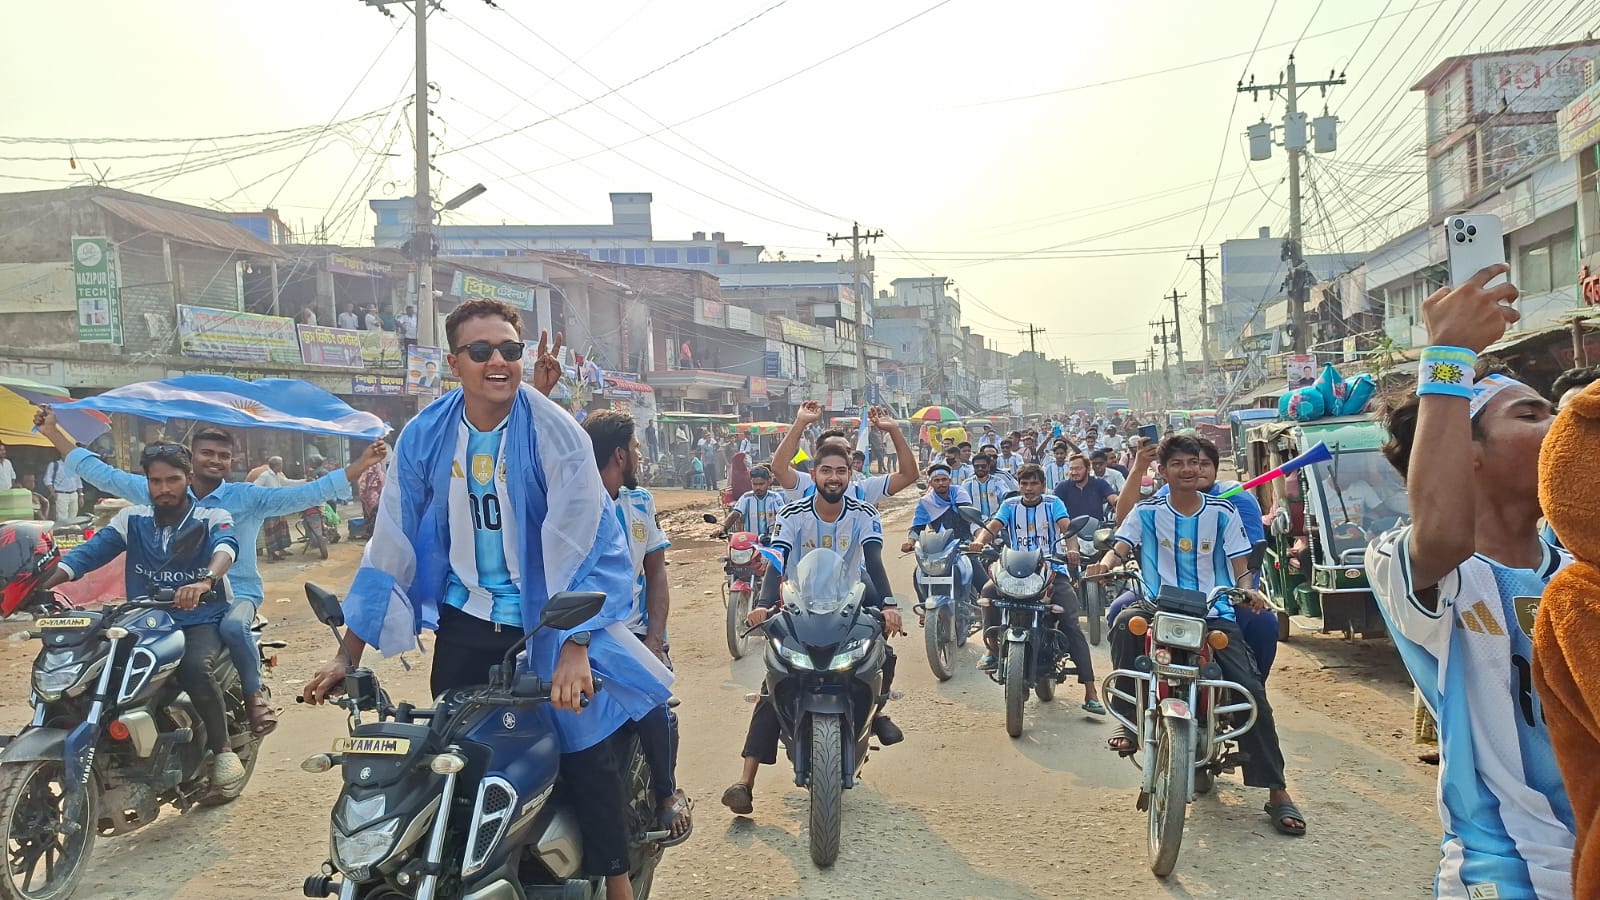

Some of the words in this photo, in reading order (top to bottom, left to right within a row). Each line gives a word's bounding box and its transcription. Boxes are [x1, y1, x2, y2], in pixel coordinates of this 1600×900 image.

[76, 272, 107, 285] NAZIPUR
[78, 287, 107, 297] TECH
[469, 493, 502, 531] 10
[1016, 535, 1051, 547] RGENTIN
[350, 739, 397, 752] YAMAHA
[81, 747, 96, 784] YAMAHA
